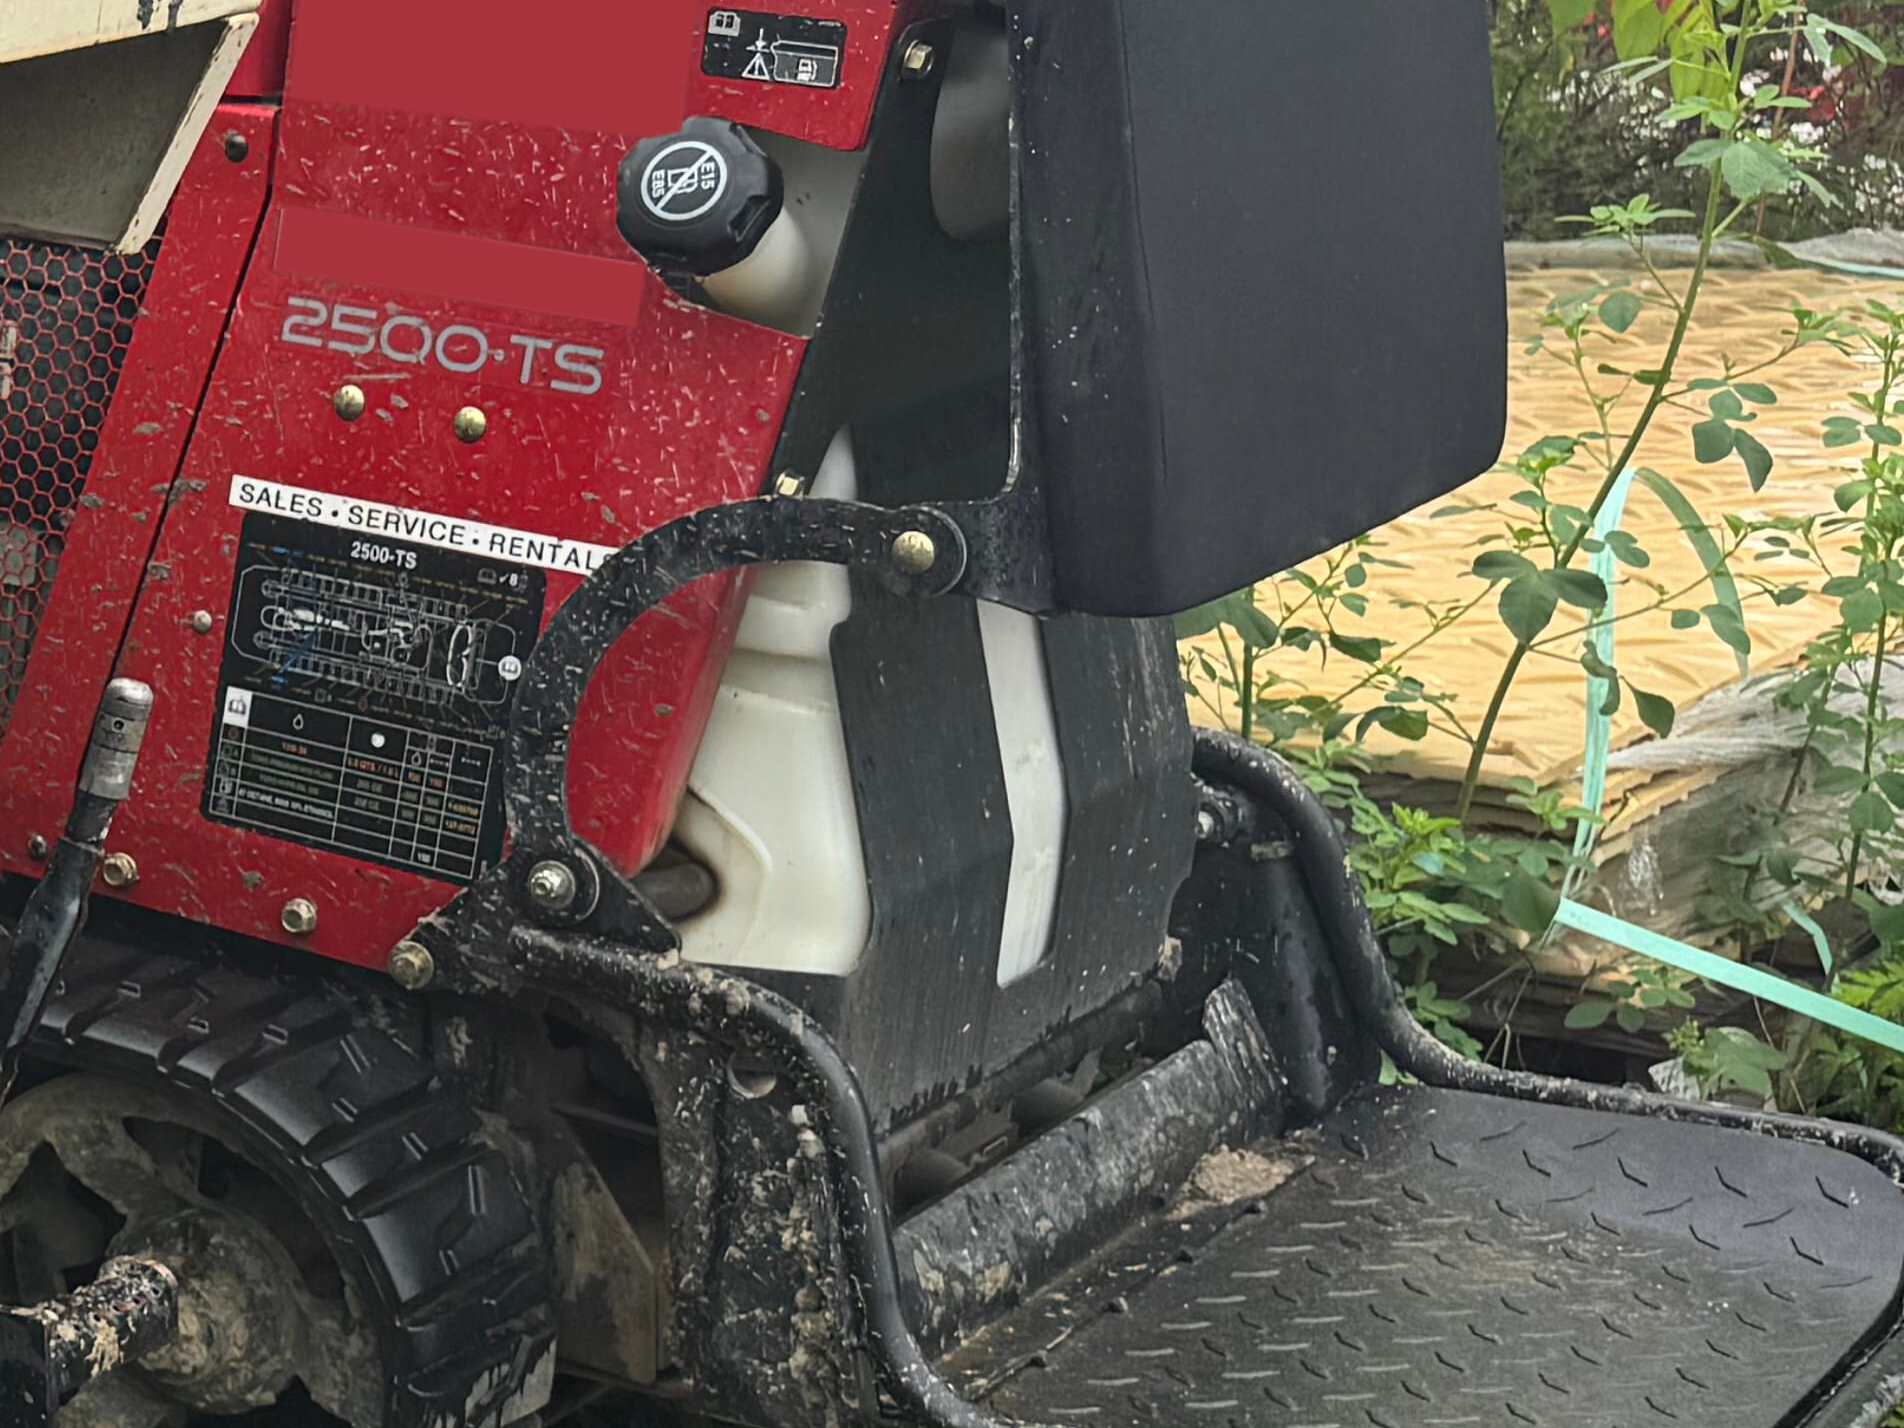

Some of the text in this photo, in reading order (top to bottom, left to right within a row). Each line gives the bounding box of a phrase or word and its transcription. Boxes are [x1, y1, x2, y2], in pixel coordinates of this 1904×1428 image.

[700, 161, 716, 190] E15
[239, 483, 323, 518] SALES
[348, 506, 465, 546] SERVICE
[350, 541, 418, 570] 2500-TS
